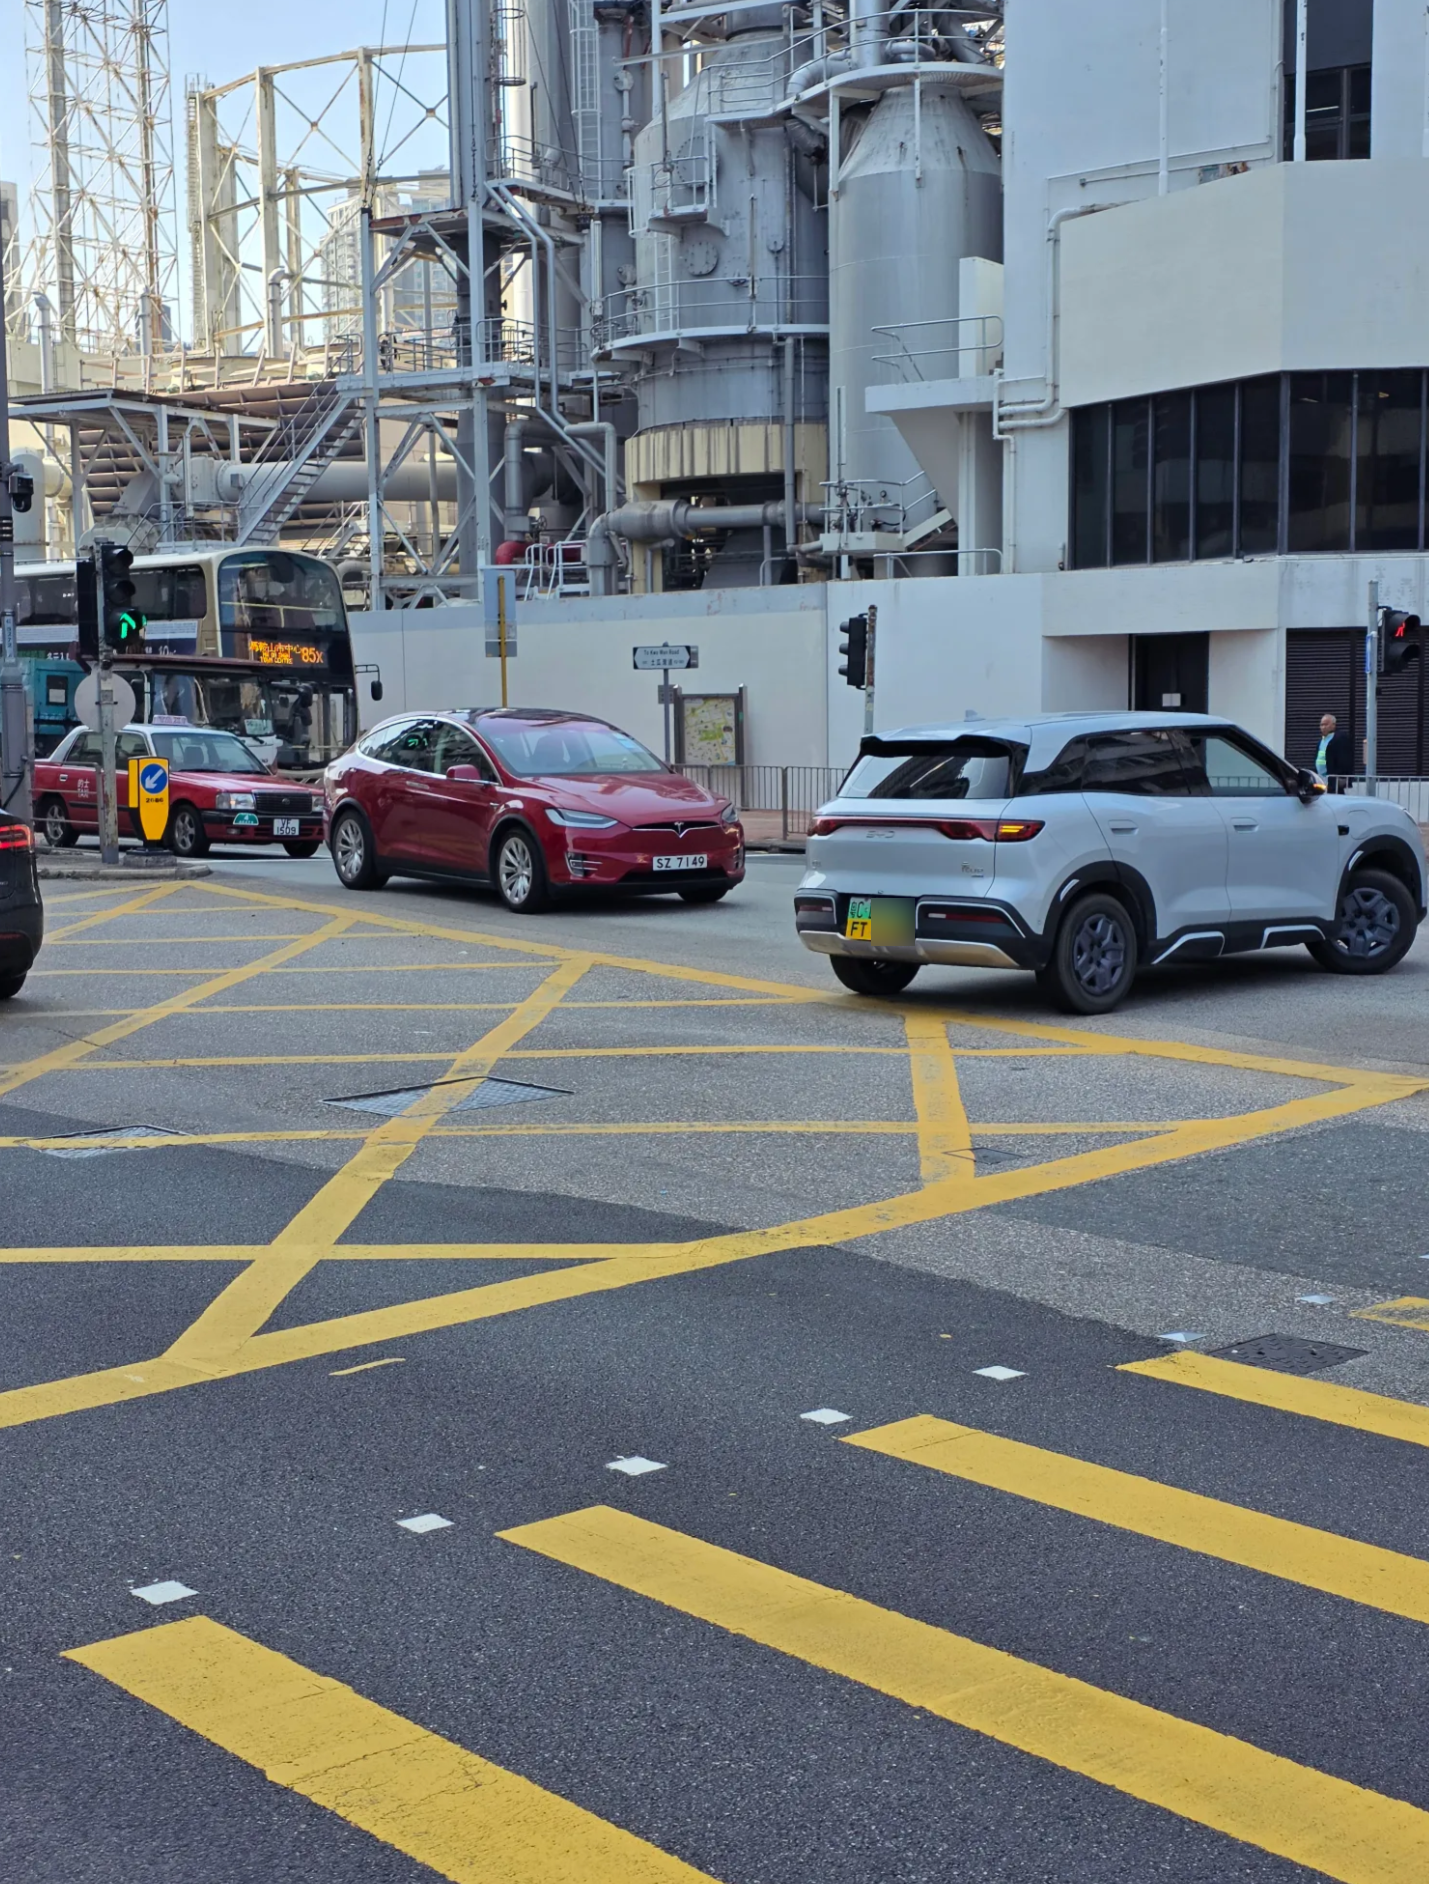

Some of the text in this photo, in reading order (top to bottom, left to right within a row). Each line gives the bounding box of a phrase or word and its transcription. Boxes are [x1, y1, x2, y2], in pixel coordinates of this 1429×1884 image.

[78, 778, 90, 788] 的士
[277, 826, 296, 835] 1509
[657, 856, 704, 869] SZ 7149
[850, 921, 868, 937] FT
